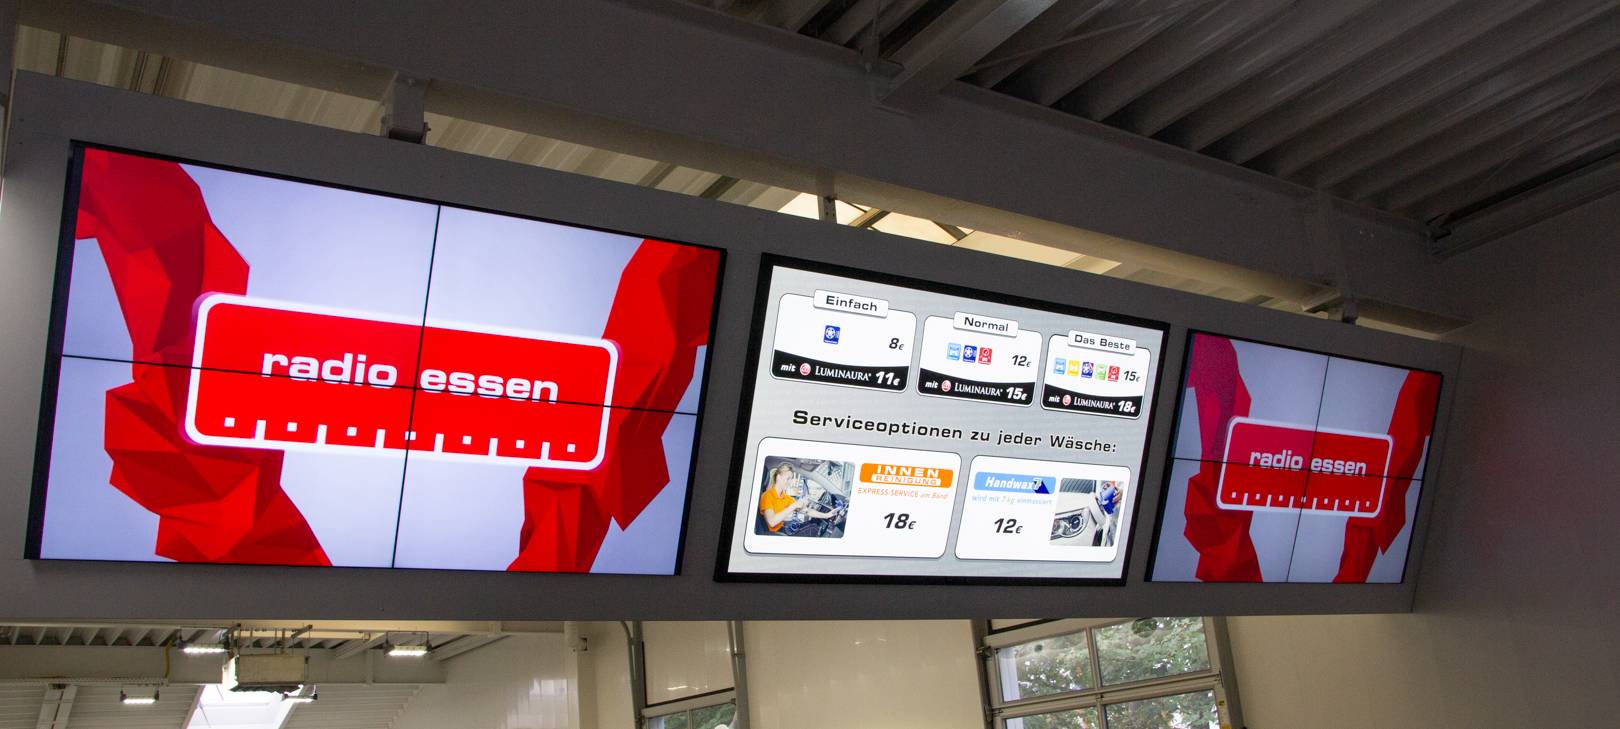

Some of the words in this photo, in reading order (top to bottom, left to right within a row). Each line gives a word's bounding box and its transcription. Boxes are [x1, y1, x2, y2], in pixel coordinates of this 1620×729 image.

[826, 295, 877, 311] Einfach
[964, 317, 1008, 332] Normal
[889, 338, 904, 350] 8€
[1075, 334, 1095, 345] Das
[1100, 338, 1130, 350] Beste
[1012, 355, 1031, 367] 12€
[262, 353, 397, 389] radio
[420, 368, 559, 405] essen
[780, 363, 796, 372] mit
[876, 371, 900, 386] 11€
[925, 380, 939, 389] mit
[1006, 387, 1028, 400] 15€
[1048, 394, 1060, 403] mit
[1118, 400, 1136, 413] 18€
[793, 410, 962, 439] Serviceoptionen
[970, 431, 990, 441] zu
[997, 430, 1042, 445] jeder
[1050, 435, 1117, 452] Wäsche:
[877, 465, 939, 478] INNEN
[1249, 450, 1303, 471] radio
[1310, 457, 1367, 477] essen
[875, 475, 938, 485] REINIGUNG
[884, 513, 917, 529] 18€
[994, 518, 1023, 533] 12€
